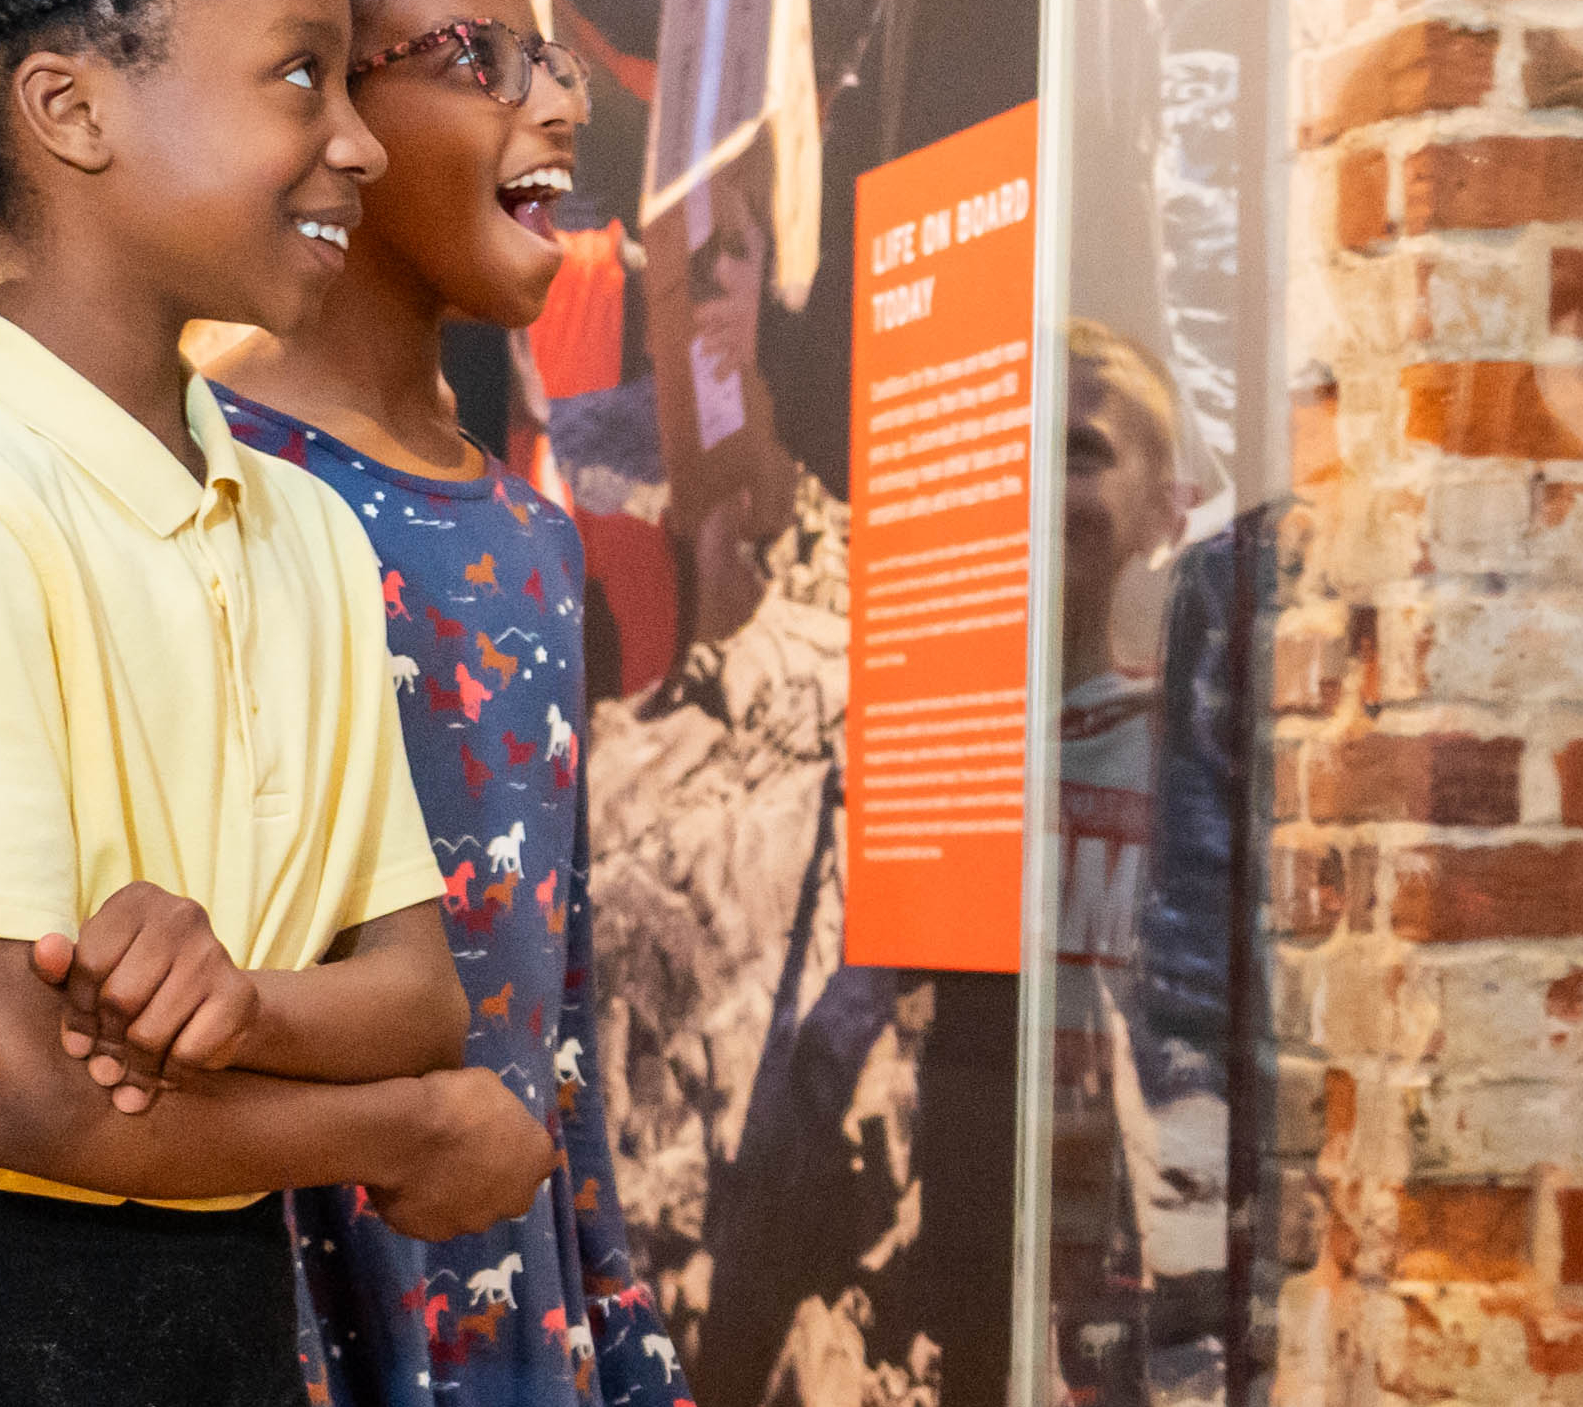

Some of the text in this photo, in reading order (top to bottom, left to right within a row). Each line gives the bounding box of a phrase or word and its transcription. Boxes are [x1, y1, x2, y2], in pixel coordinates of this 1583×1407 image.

[872, 177, 1030, 275] LIFE ON BOARD
[872, 274, 935, 334] TODAY
